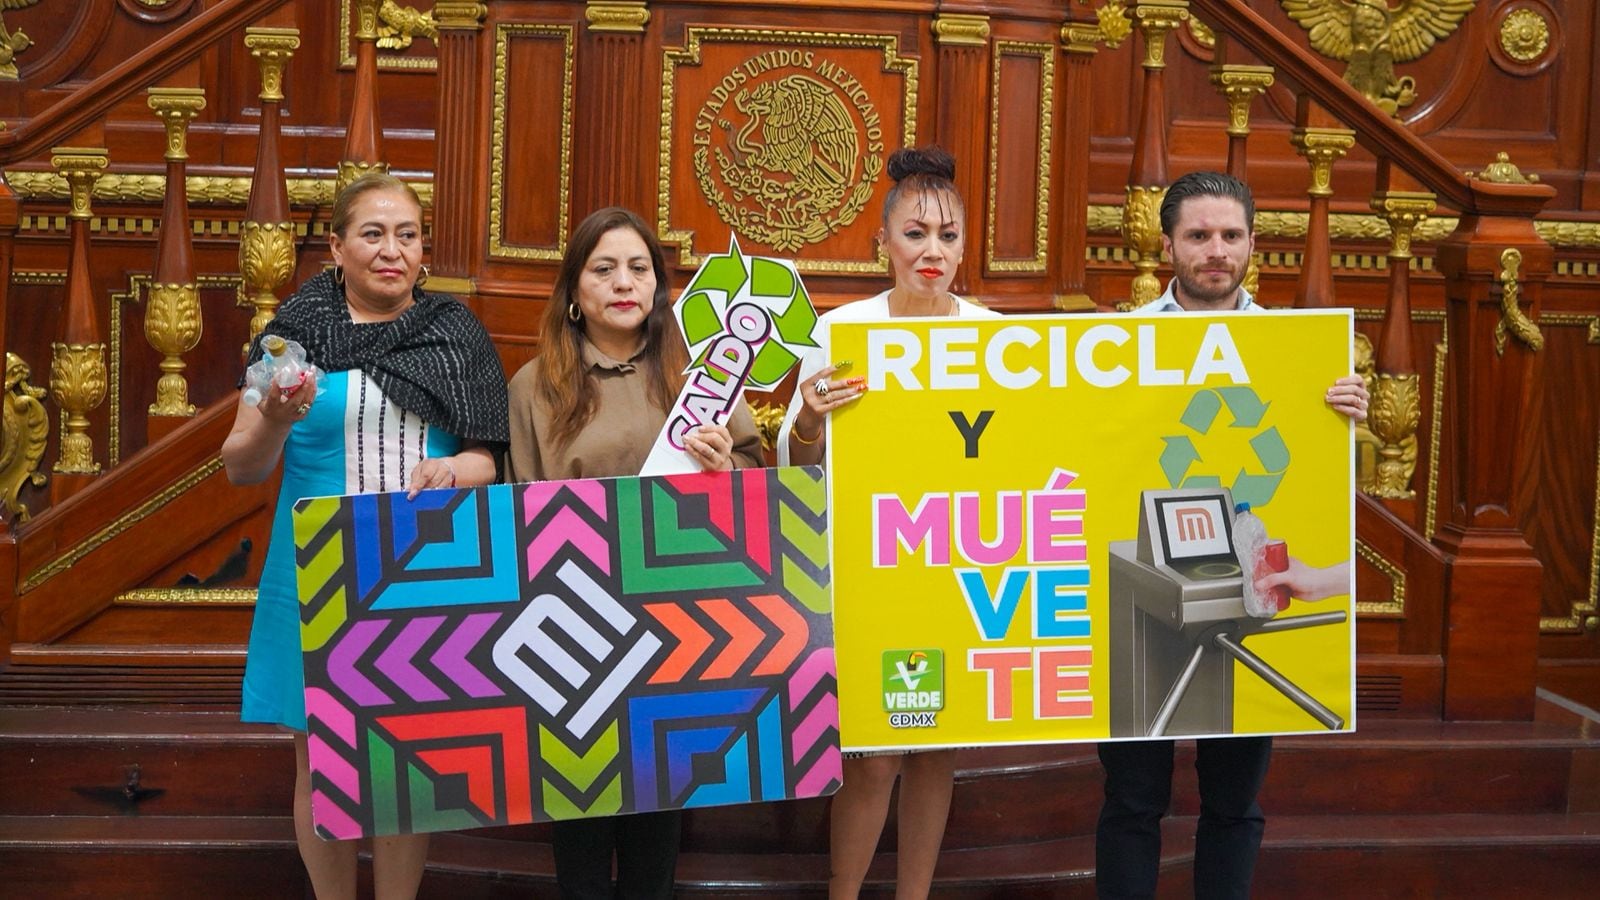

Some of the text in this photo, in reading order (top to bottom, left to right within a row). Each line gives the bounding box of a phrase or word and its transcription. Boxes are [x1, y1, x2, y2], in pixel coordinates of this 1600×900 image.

[693, 49, 883, 153] ESTADOS UNIDOS MEXICANOS
[867, 323, 1251, 391] RECICLA
[948, 410, 995, 459] Y
[872, 467, 1087, 569] MUÉ
[954, 567, 1092, 642] VE
[884, 690, 941, 709] VERDE
[889, 712, 935, 727] CDMX
[967, 647, 1094, 722] TE
